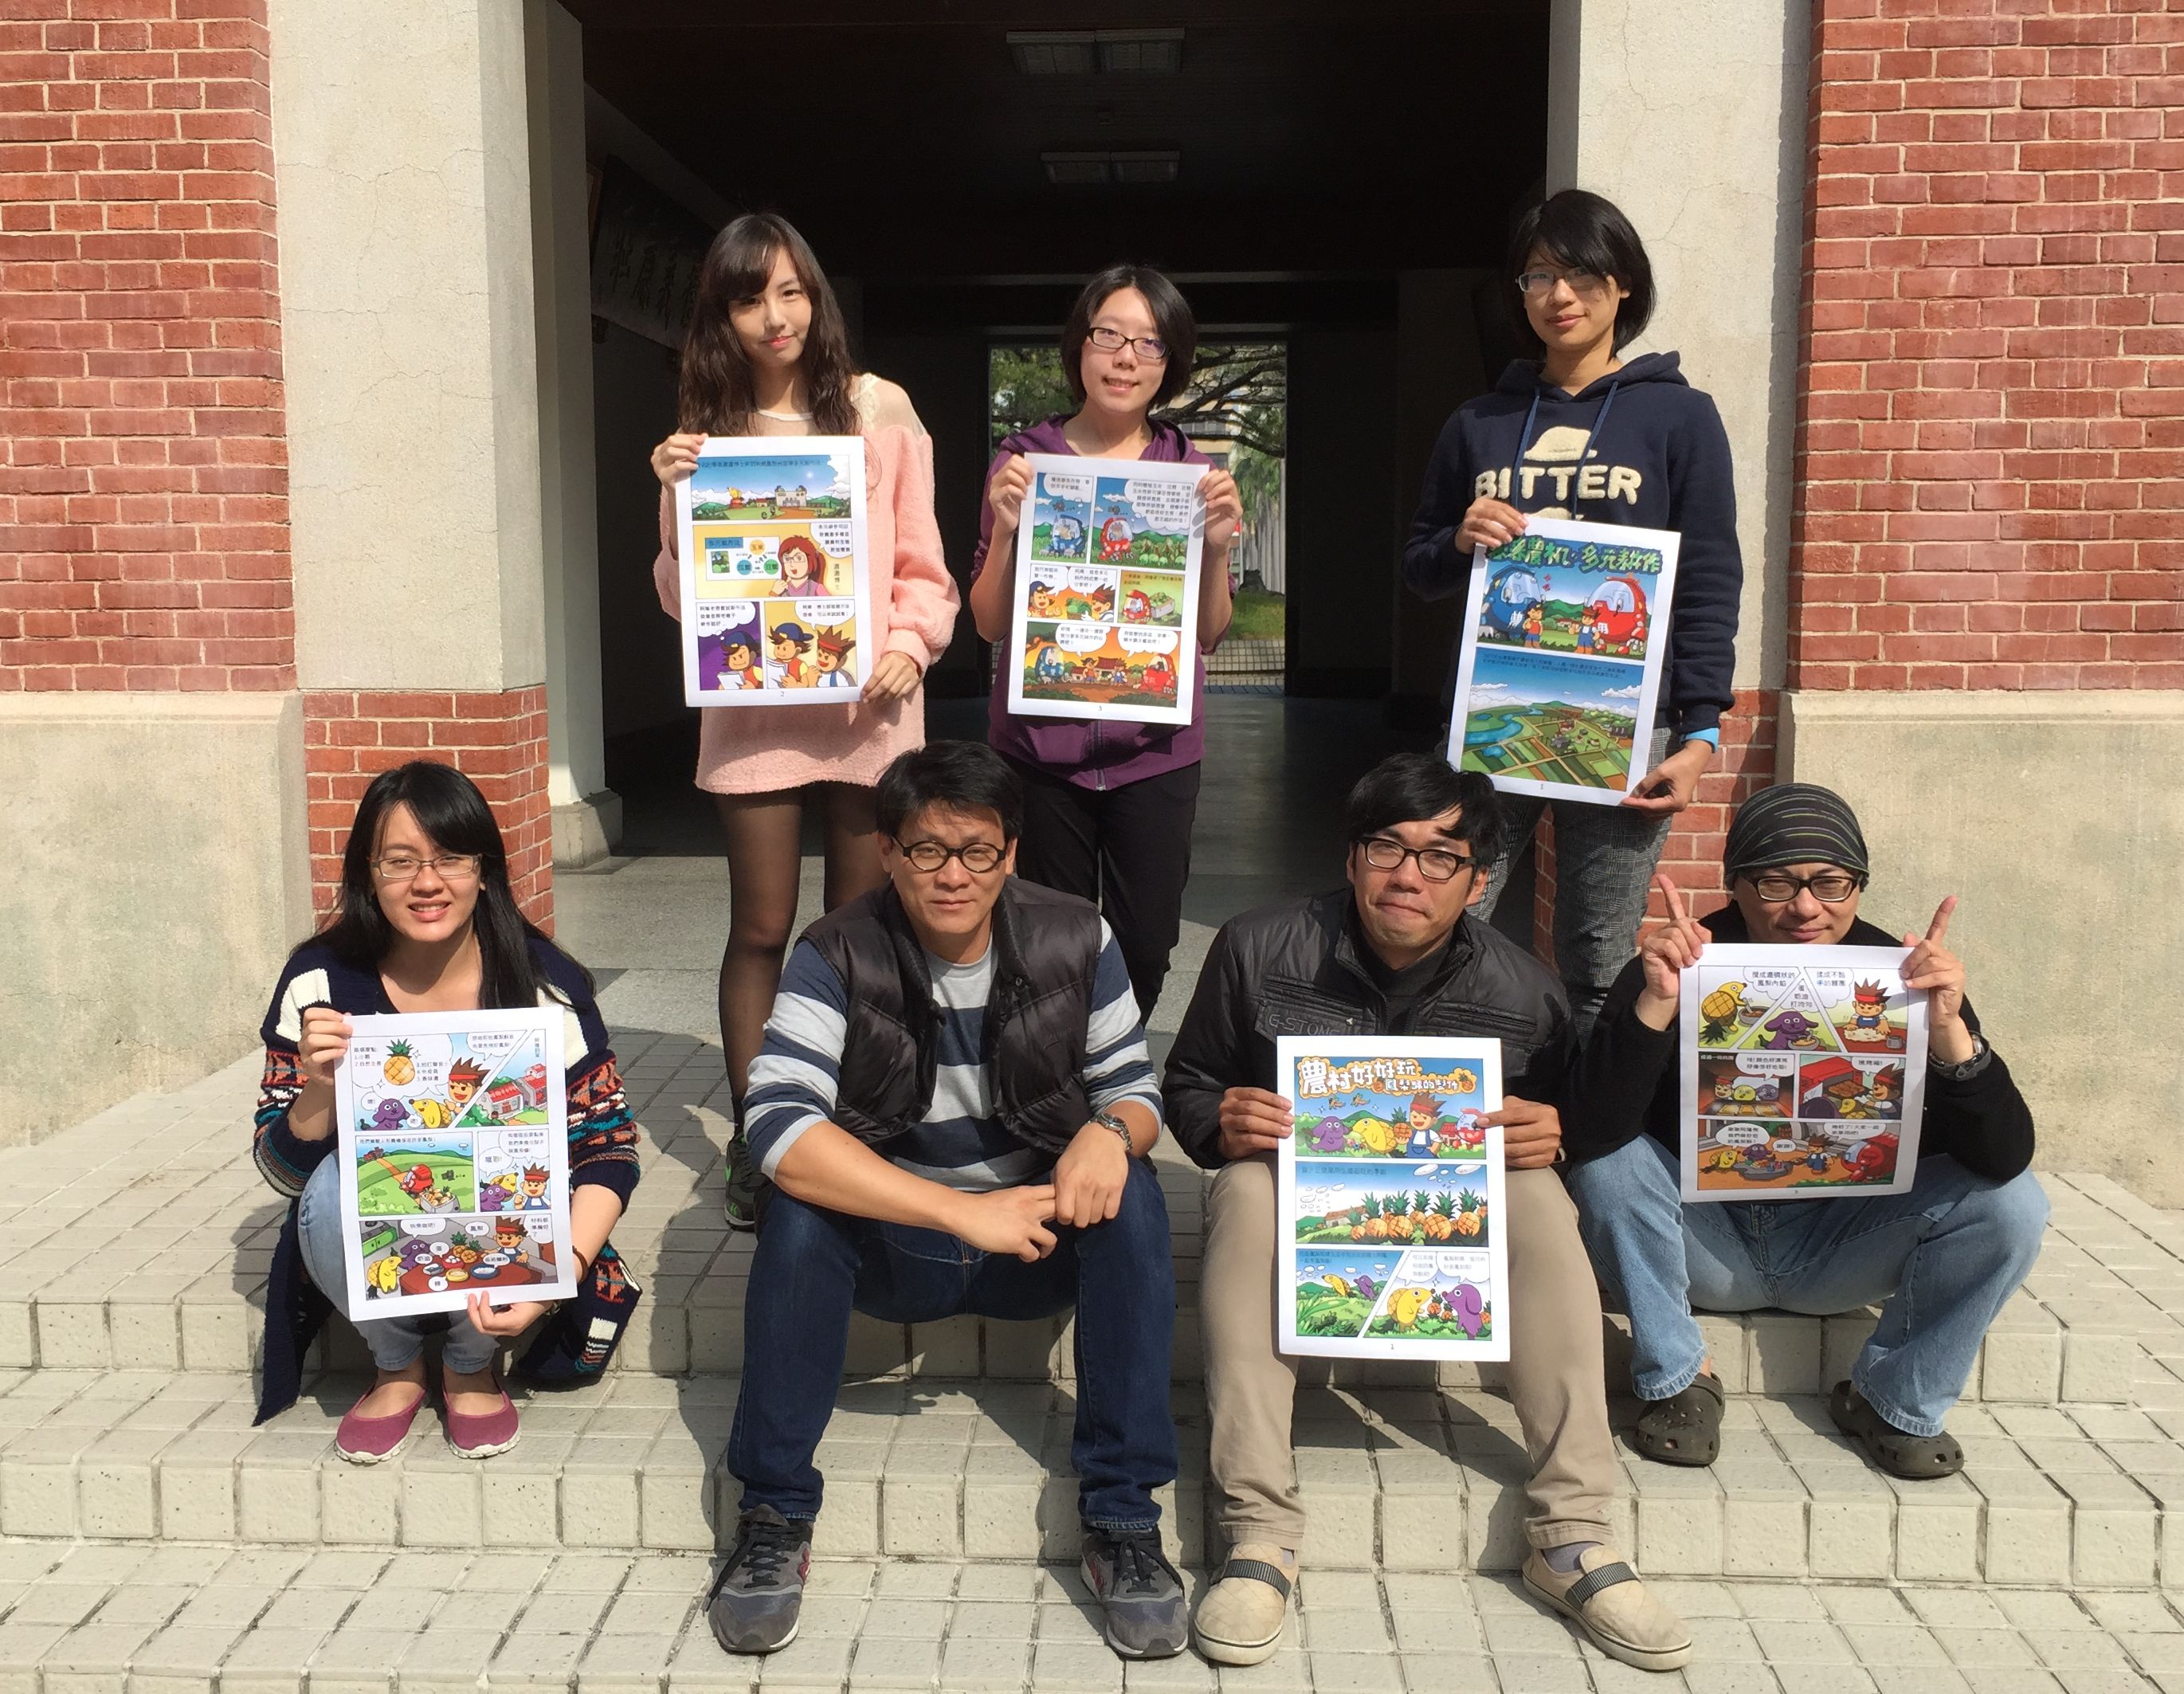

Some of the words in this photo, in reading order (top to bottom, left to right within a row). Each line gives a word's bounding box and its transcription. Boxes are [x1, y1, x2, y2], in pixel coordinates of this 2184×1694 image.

[1475, 465, 1641, 505] BITTER
[1300, 1059, 1417, 1095] 農村好好玩
